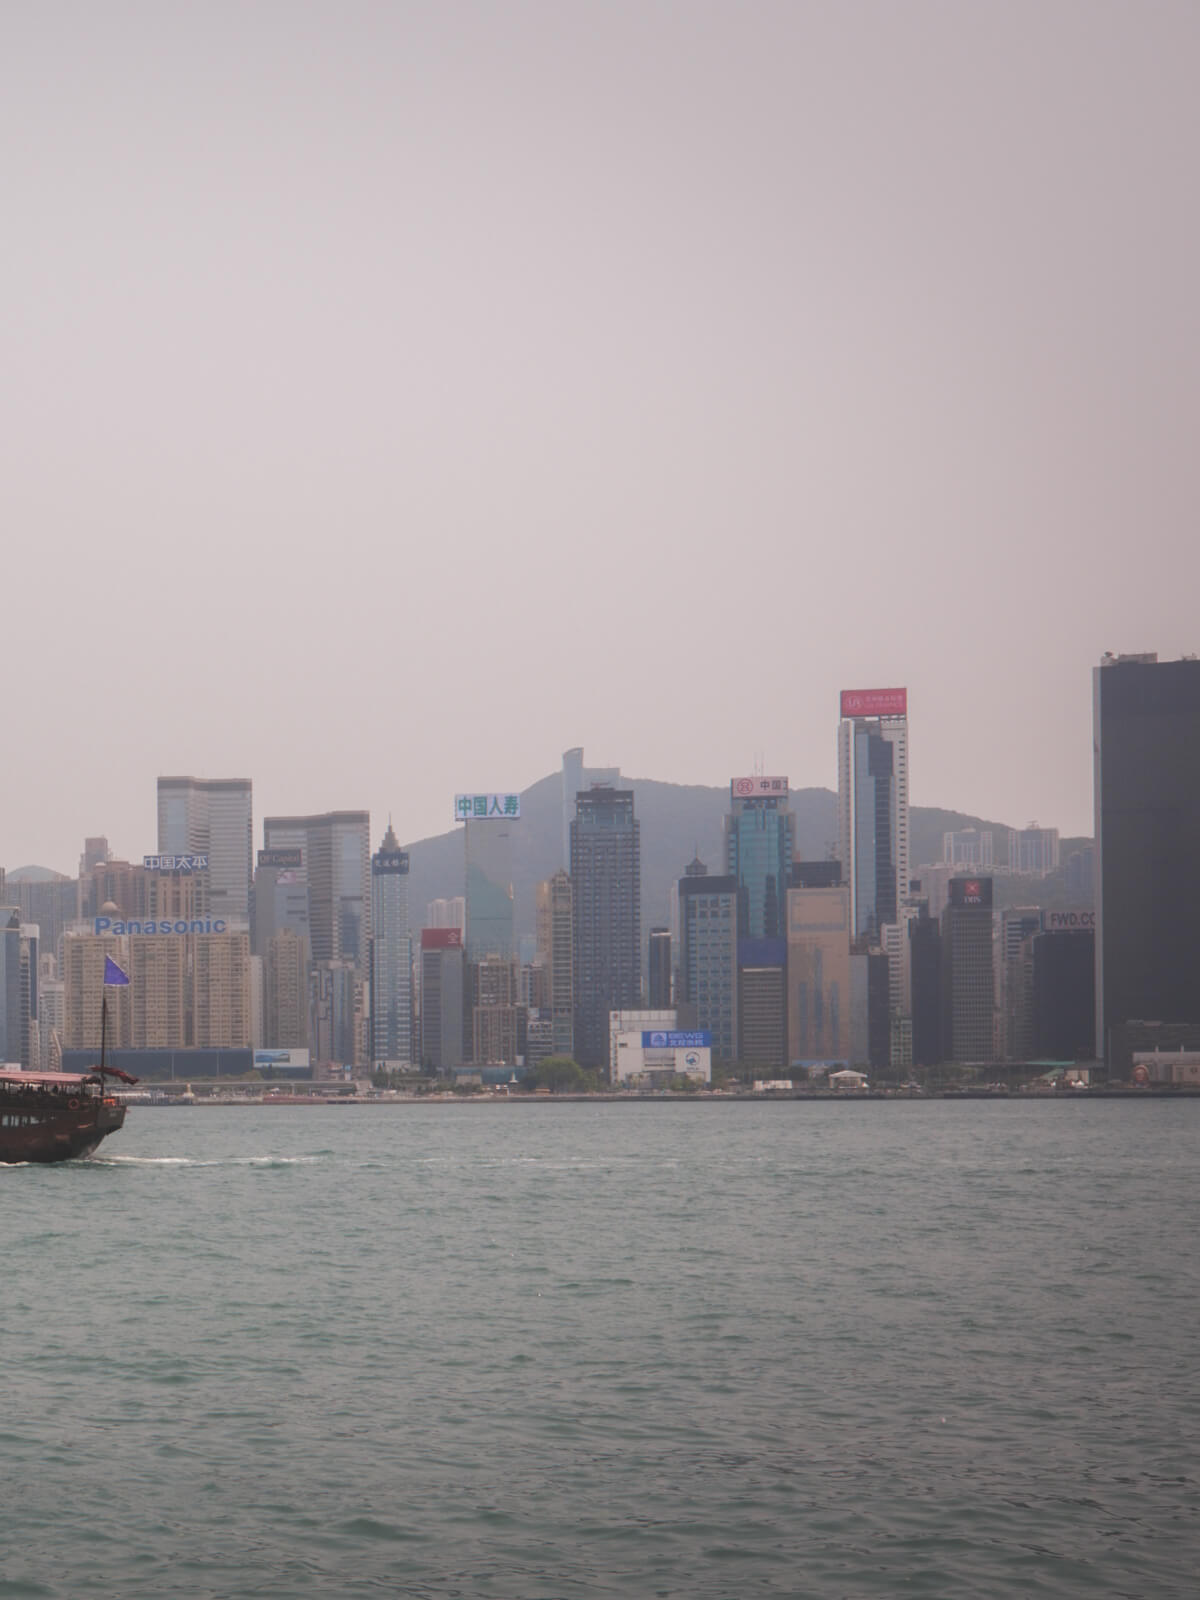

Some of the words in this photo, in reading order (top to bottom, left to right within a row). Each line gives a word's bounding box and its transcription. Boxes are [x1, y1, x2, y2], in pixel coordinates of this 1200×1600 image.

[458, 794, 519, 816] 中国人寿
[95, 915, 226, 936] Panasonic
